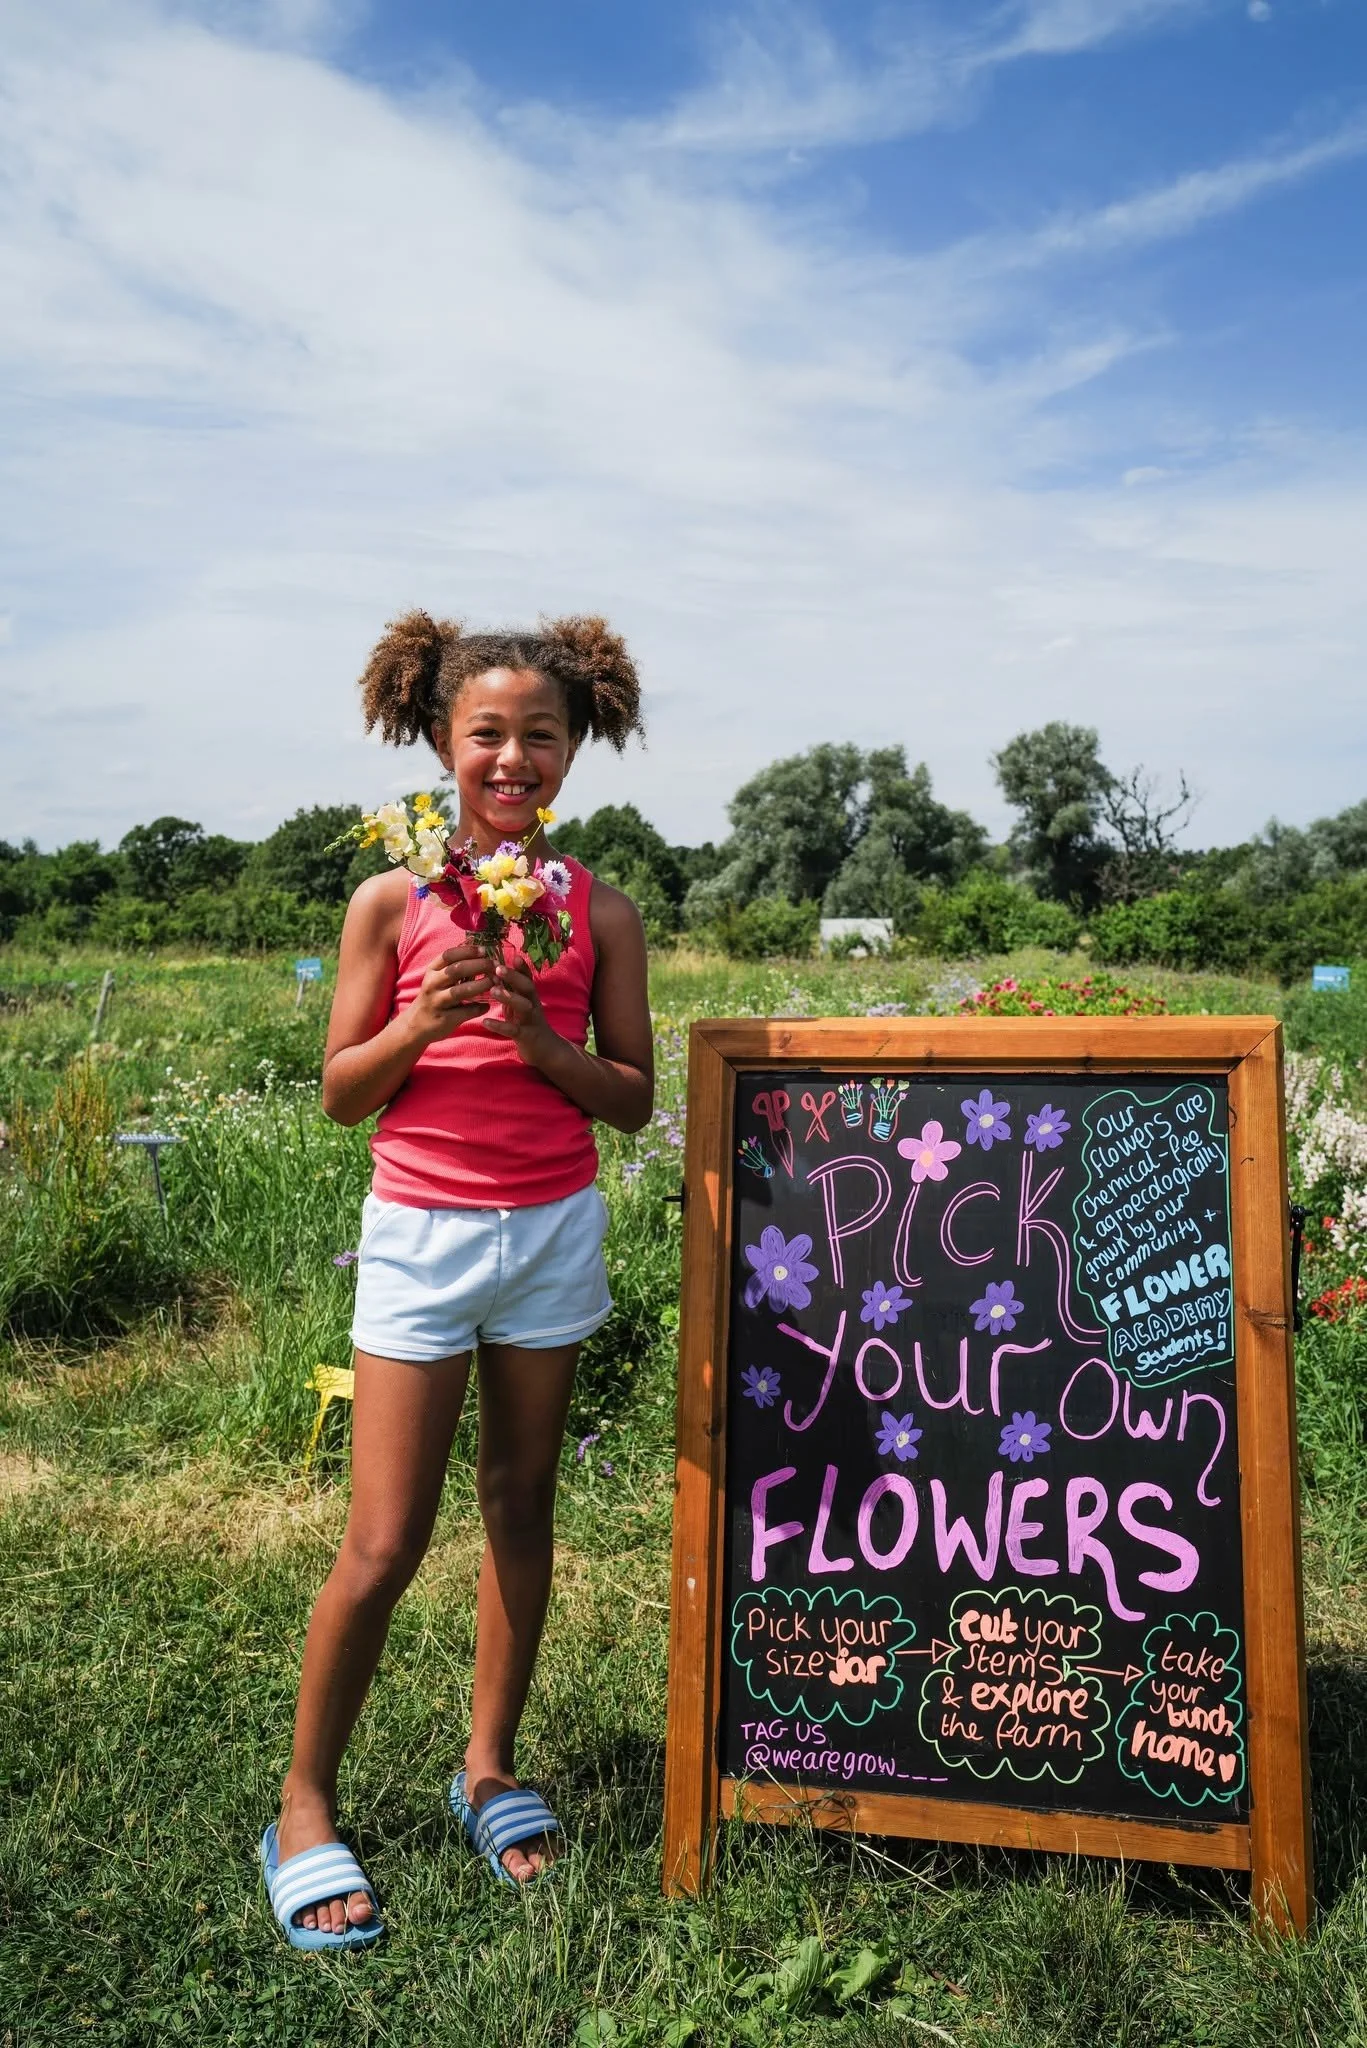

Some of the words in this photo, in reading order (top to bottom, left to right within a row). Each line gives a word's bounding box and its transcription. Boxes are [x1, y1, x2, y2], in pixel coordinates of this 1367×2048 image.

[1176, 1094, 1207, 1123] are
[1080, 1235, 1098, 1250] &
[1085, 1235, 1131, 1283] grown
[1127, 1218, 1157, 1241] by
[1154, 1192, 1186, 1222] our
[1105, 1217, 1202, 1289] community
[1100, 1243, 1230, 1323] FLOWER
[1114, 1287, 1232, 1357] ACADEMY
[750, 1463, 1202, 1622] FLOWERS
[748, 1607, 811, 1642] Pick
[820, 1616, 893, 1661] your
[1024, 1615, 1087, 1658] your
[828, 1647, 886, 1686] jar
[1161, 1640, 1227, 1683] take
[941, 1675, 964, 1709] &
[970, 1679, 1089, 1720] explore
[1149, 1679, 1206, 1714] your
[741, 1718, 790, 1741] TAG
[796, 1721, 827, 1745] US
[940, 1712, 985, 1741] the
[996, 1710, 1083, 1752] farm
[1167, 1702, 1235, 1737] bunch
[1131, 1719, 1217, 1777] home
